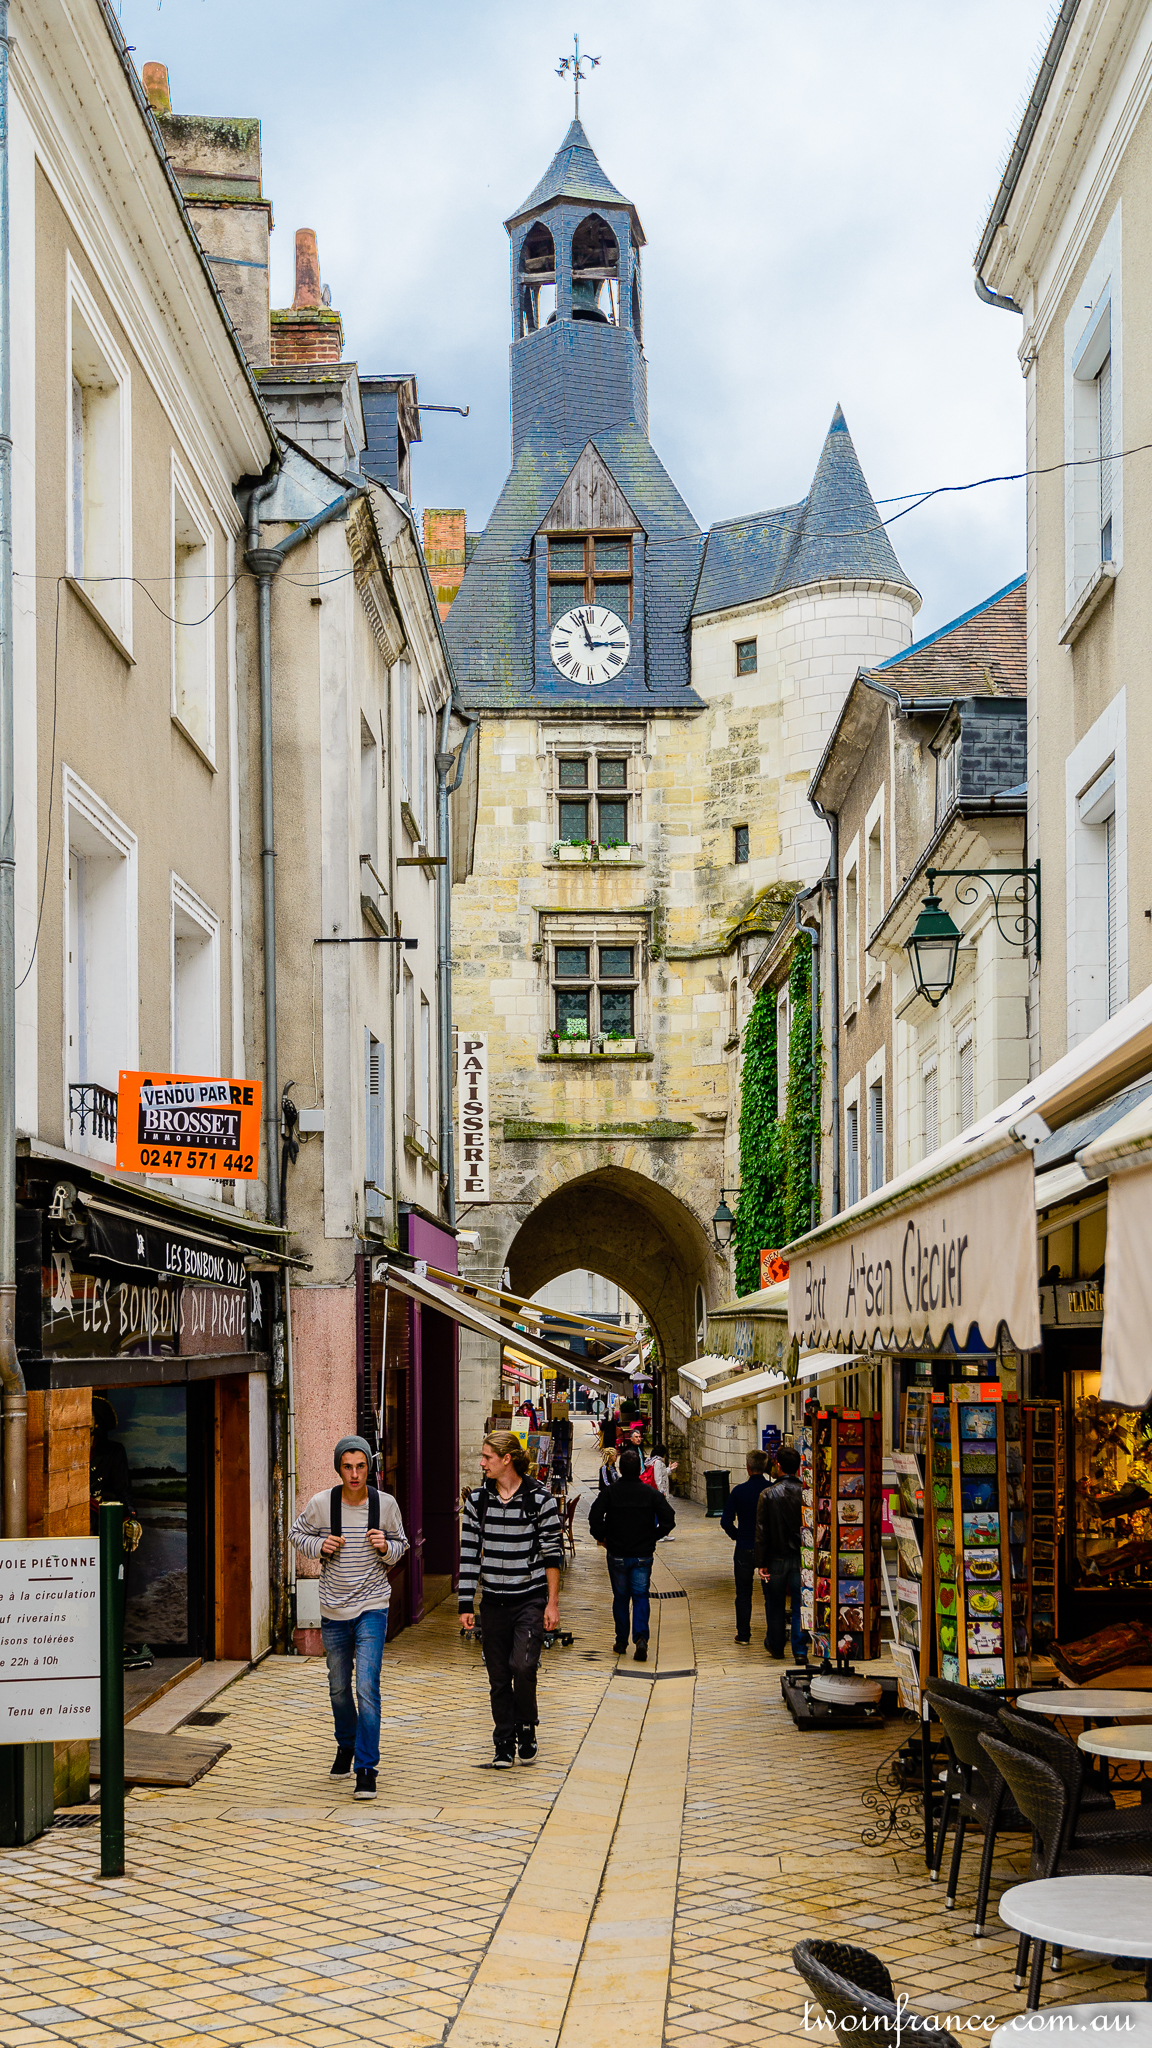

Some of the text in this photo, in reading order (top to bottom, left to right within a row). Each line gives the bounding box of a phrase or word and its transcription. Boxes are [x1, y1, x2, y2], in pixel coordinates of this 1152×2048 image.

[144, 1087, 196, 1106] VENDU
[200, 1085, 228, 1103] PAR
[143, 1109, 238, 1136] BROSSET
[463, 1041, 485, 1193] PATISSERIE
[143, 1132, 237, 1146] IMMOBILIER
[186, 1151, 217, 1170] 571
[223, 1153, 254, 1173] 442
[166, 1242, 181, 1273] LES
[184, 1247, 224, 1282] BONBONS
[227, 1258, 239, 1285] DU
[902, 1218, 968, 1314] Glacier
[83, 1276, 247, 1338] LES BONBONS DU PIRATE
[0, 1556, 96, 1570] VOIE PIÉTONNE
[9, 1591, 15, 1601] à
[20, 1591, 30, 1601] la
[35, 1588, 96, 1600] circulation
[17, 1612, 67, 1624] riverains
[33, 1634, 75, 1645] tolérées
[10, 1657, 29, 1667] 22h
[33, 1657, 39, 1666] à
[42, 1655, 59, 1665] 10h
[7, 1703, 92, 1717] Tenu en laisse
